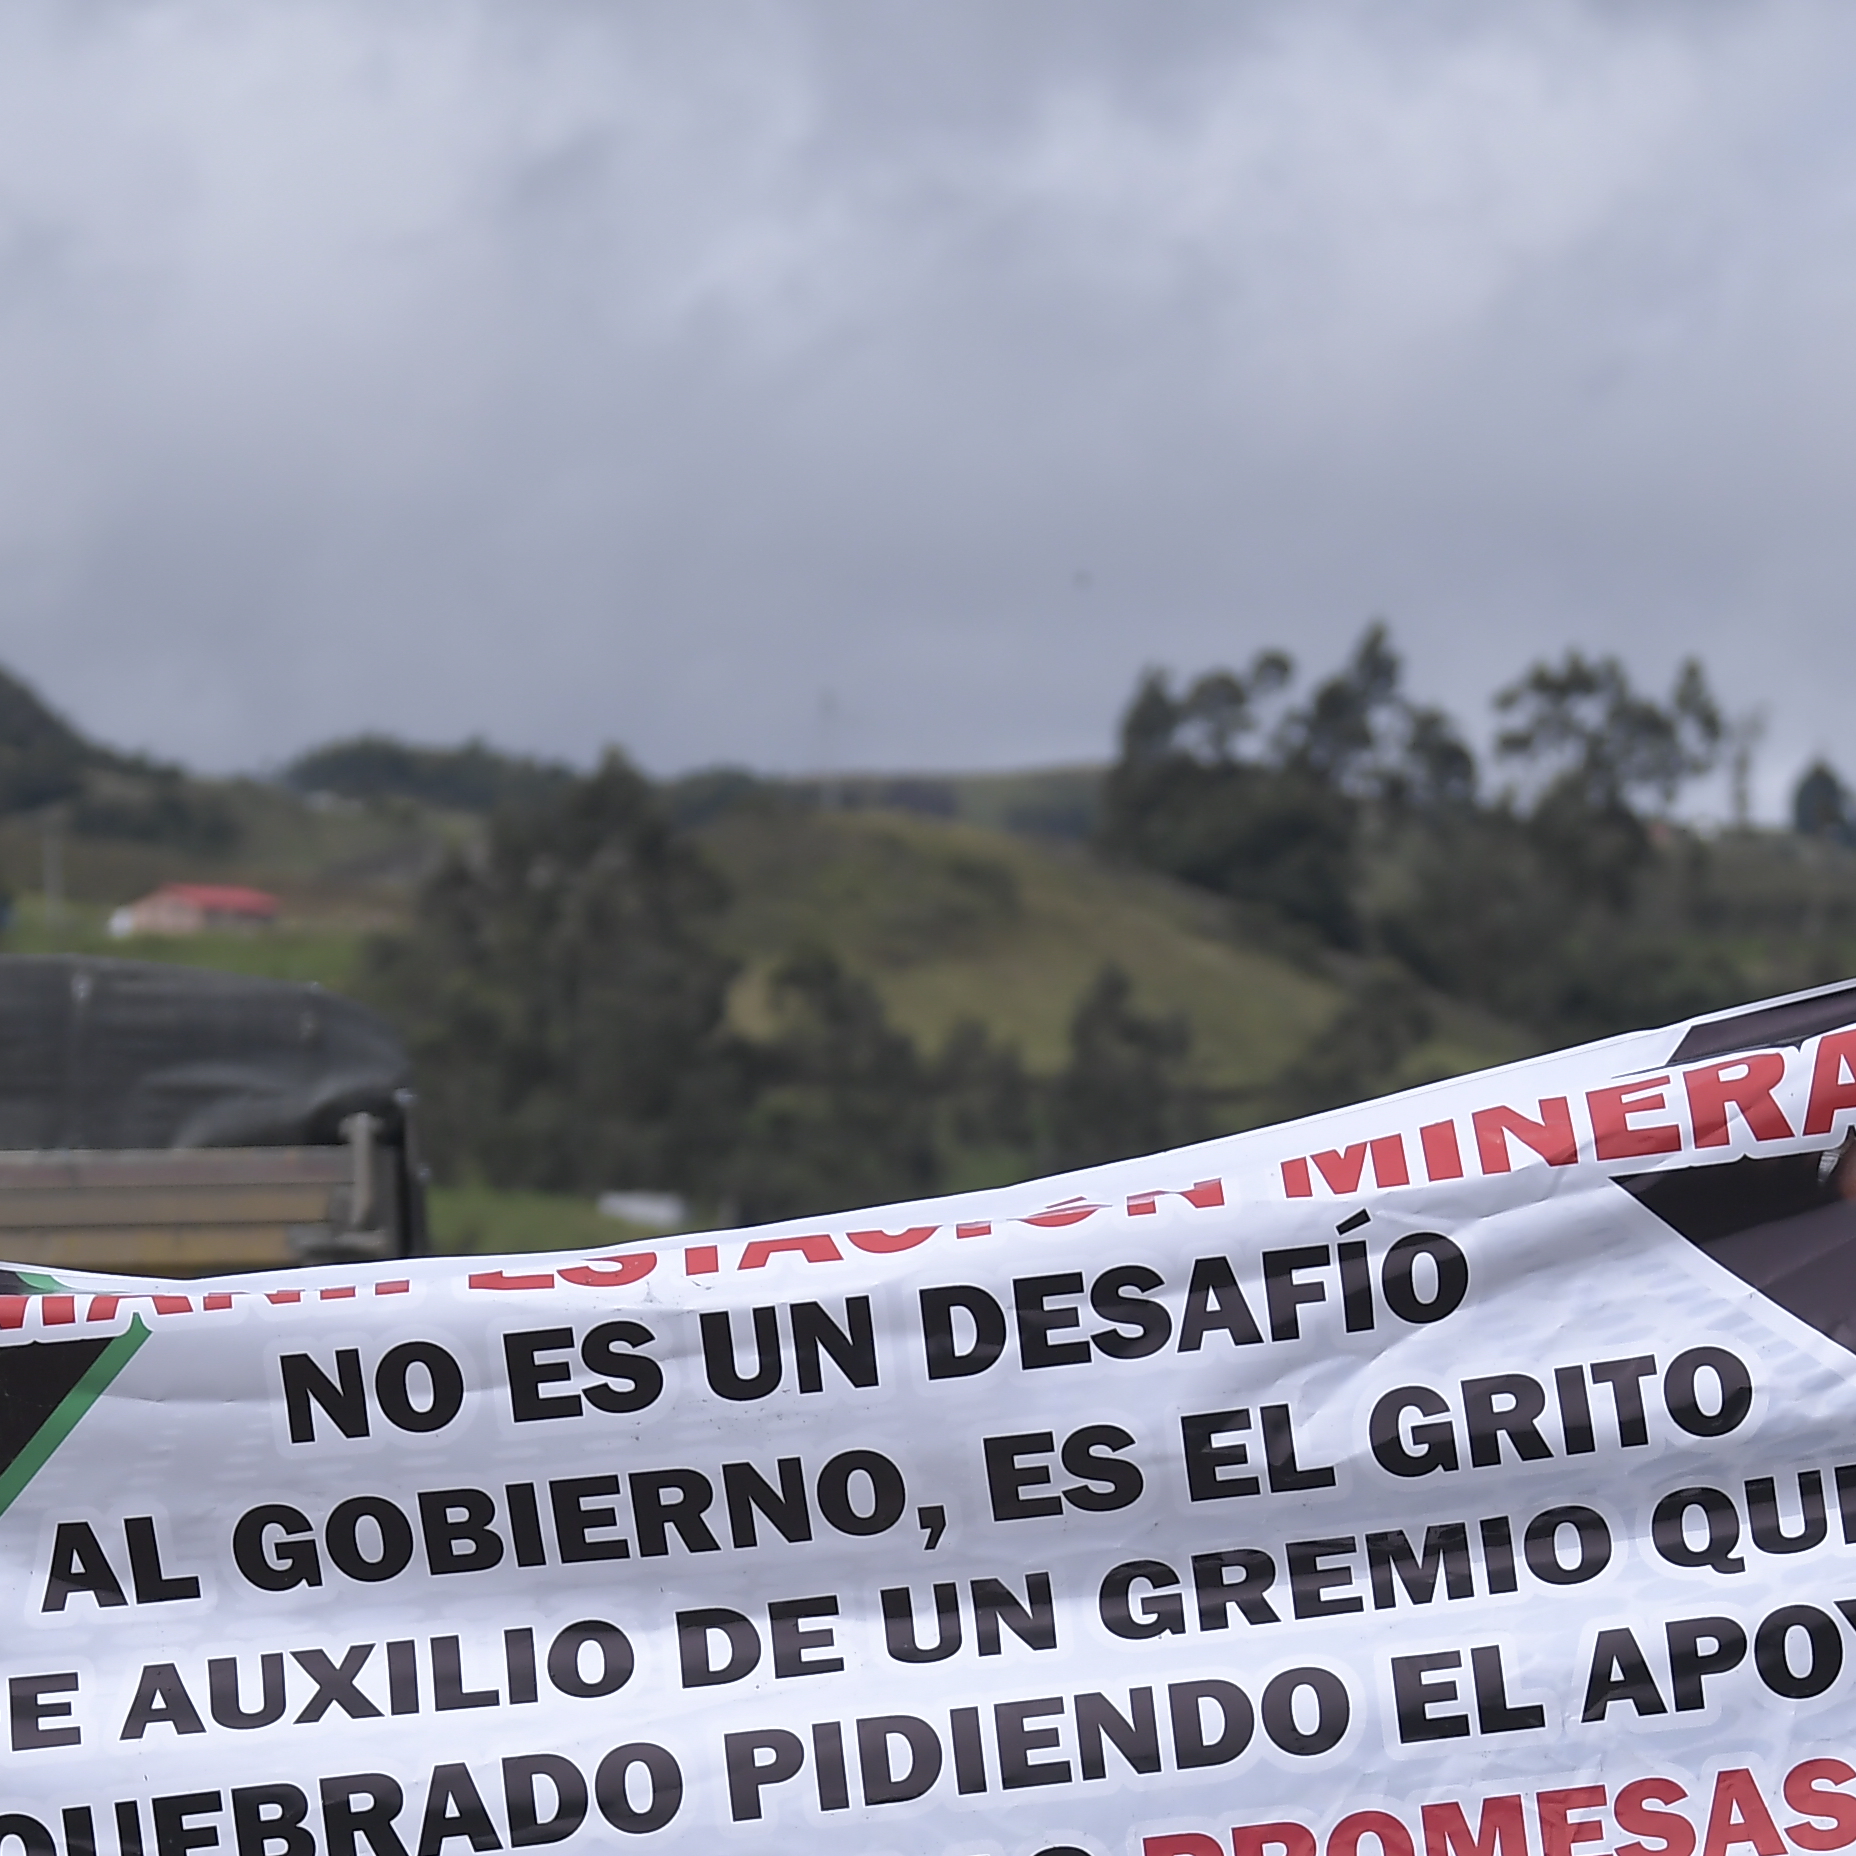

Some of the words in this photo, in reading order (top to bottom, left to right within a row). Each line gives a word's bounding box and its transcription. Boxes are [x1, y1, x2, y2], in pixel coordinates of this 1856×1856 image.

[280, 1341, 464, 1443] NO
[503, 1321, 663, 1423] ES
[699, 1295, 879, 1401] UN
[919, 1209, 1468, 1380] DESAFÍO
[42, 1516, 201, 1612] AL
[233, 1450, 946, 1591] GOBIERNO,
[984, 1425, 1143, 1522] ES
[1181, 1404, 1336, 1502] EL
[1369, 1347, 1752, 1477] GRITO
[120, 1620, 634, 1740] AUXILIO
[676, 1595, 844, 1688] DE
[880, 1572, 1057, 1663] UN
[1099, 1505, 1611, 1639] GREMIO
[724, 1667, 1350, 1822] PIDIENDO
[1391, 1645, 1545, 1744] EL
